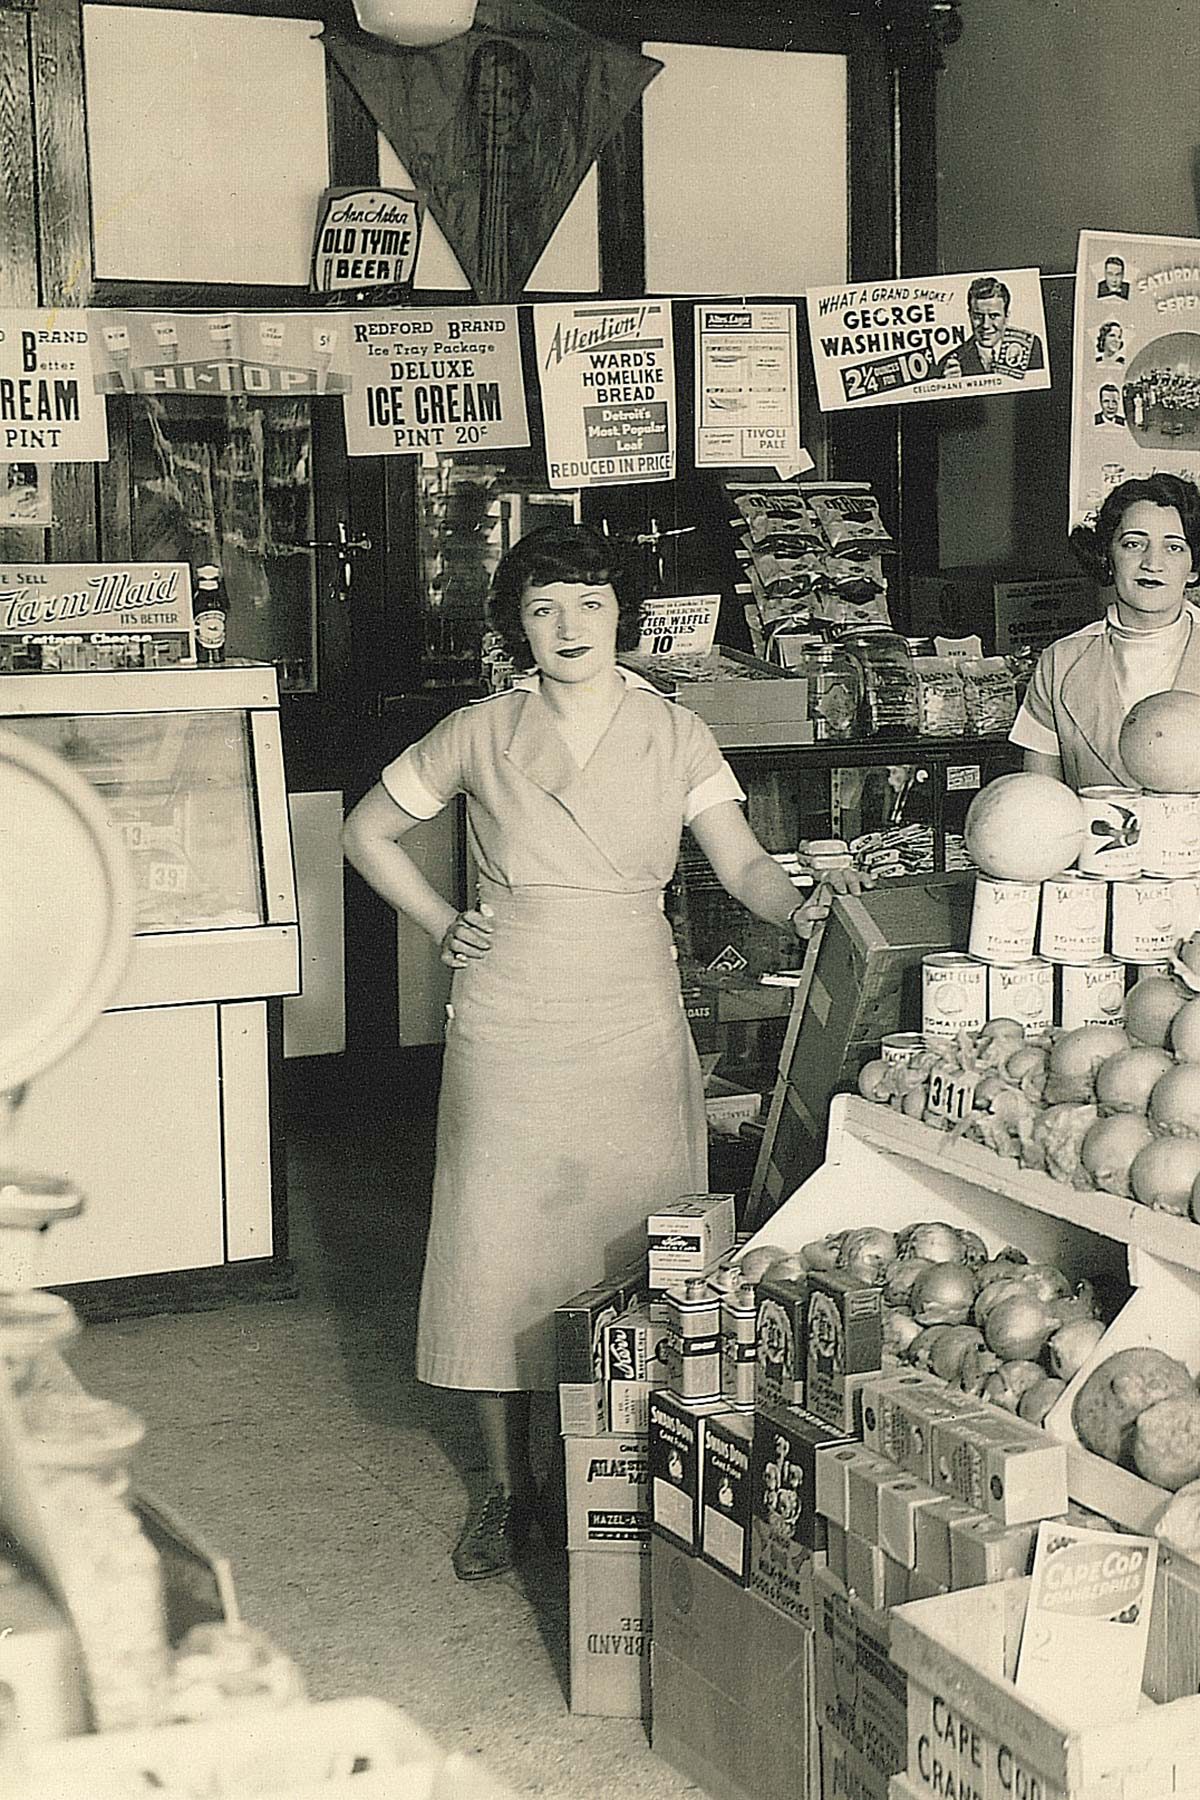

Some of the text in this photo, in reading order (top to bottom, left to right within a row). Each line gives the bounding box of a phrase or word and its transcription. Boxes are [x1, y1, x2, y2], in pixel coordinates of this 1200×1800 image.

[322, 228, 411, 256] OLD TYME
[336, 259, 389, 279] BEER
[819, 287, 954, 316] WHAT A GRAND SMOKE!
[843, 304, 935, 330] GEORGE
[354, 321, 506, 342] REDFORD BRAND
[545, 306, 646, 371] Attention!
[820, 325, 967, 357] WASHINGTON
[368, 342, 495, 356] Ice Tray Package
[590, 351, 656, 369] WARD'S
[144, 362, 309, 391] HI-TOP
[390, 360, 474, 380] DELUXE
[582, 368, 663, 386] HOMELIKE
[597, 386, 655, 403] BREAD
[913, 378, 1002, 394] CELLOPHANE WRAPPED
[367, 382, 502, 426] ICE CREAM
[602, 408, 651, 421] Detroit's
[6, 429, 61, 448] PINT
[394, 428, 444, 447] PINT
[588, 422, 667, 437] Most Popular
[746, 429, 786, 438] TIVOLI
[616, 439, 644, 451] Loaf
[759, 440, 786, 449] PALE
[551, 460, 615, 479] REDUCED
[619, 458, 634, 473] IN
[17, 573, 47, 584] SELL
[88, 569, 179, 613] Maid
[140, 613, 178, 624] BETTER
[671, 614, 710, 625] WAFFLE
[640, 625, 695, 636] OOKIES
[924, 1019, 979, 1028] TOMATOES
[932, 1077, 943, 1106] 3
[593, 1515, 638, 1524] HAZEL-A
[1103, 1551, 1142, 1578] COD
[933, 1695, 981, 1769] CAPE
